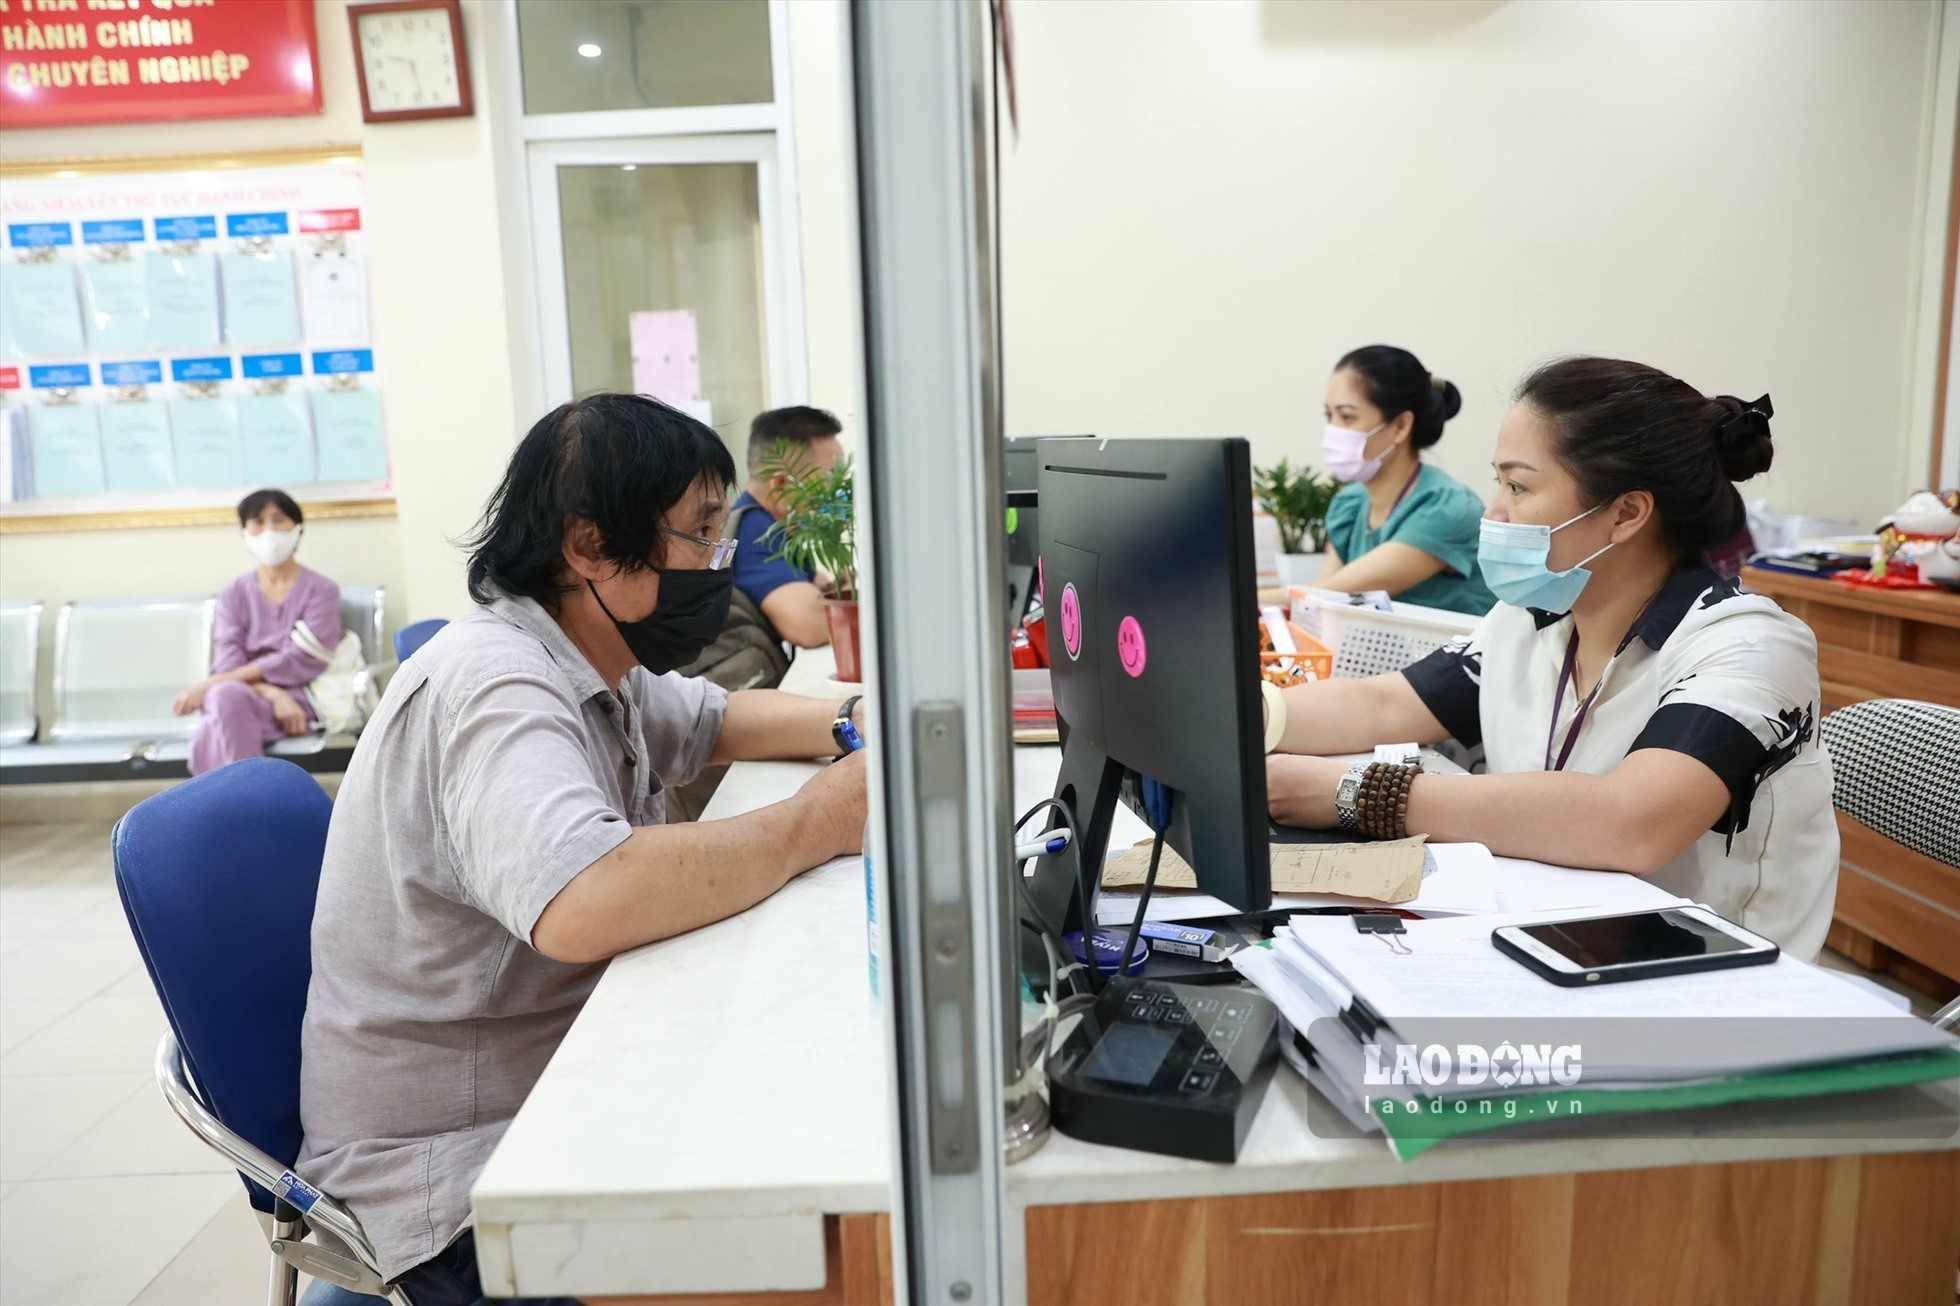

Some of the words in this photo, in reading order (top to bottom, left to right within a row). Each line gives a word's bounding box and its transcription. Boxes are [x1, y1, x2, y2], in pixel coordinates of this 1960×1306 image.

[1, 18, 88, 51] HÀNH
[95, 14, 193, 48] CHÍNH
[8, 54, 130, 88] CHUYÊN
[138, 49, 250, 86] NGHIỆP
